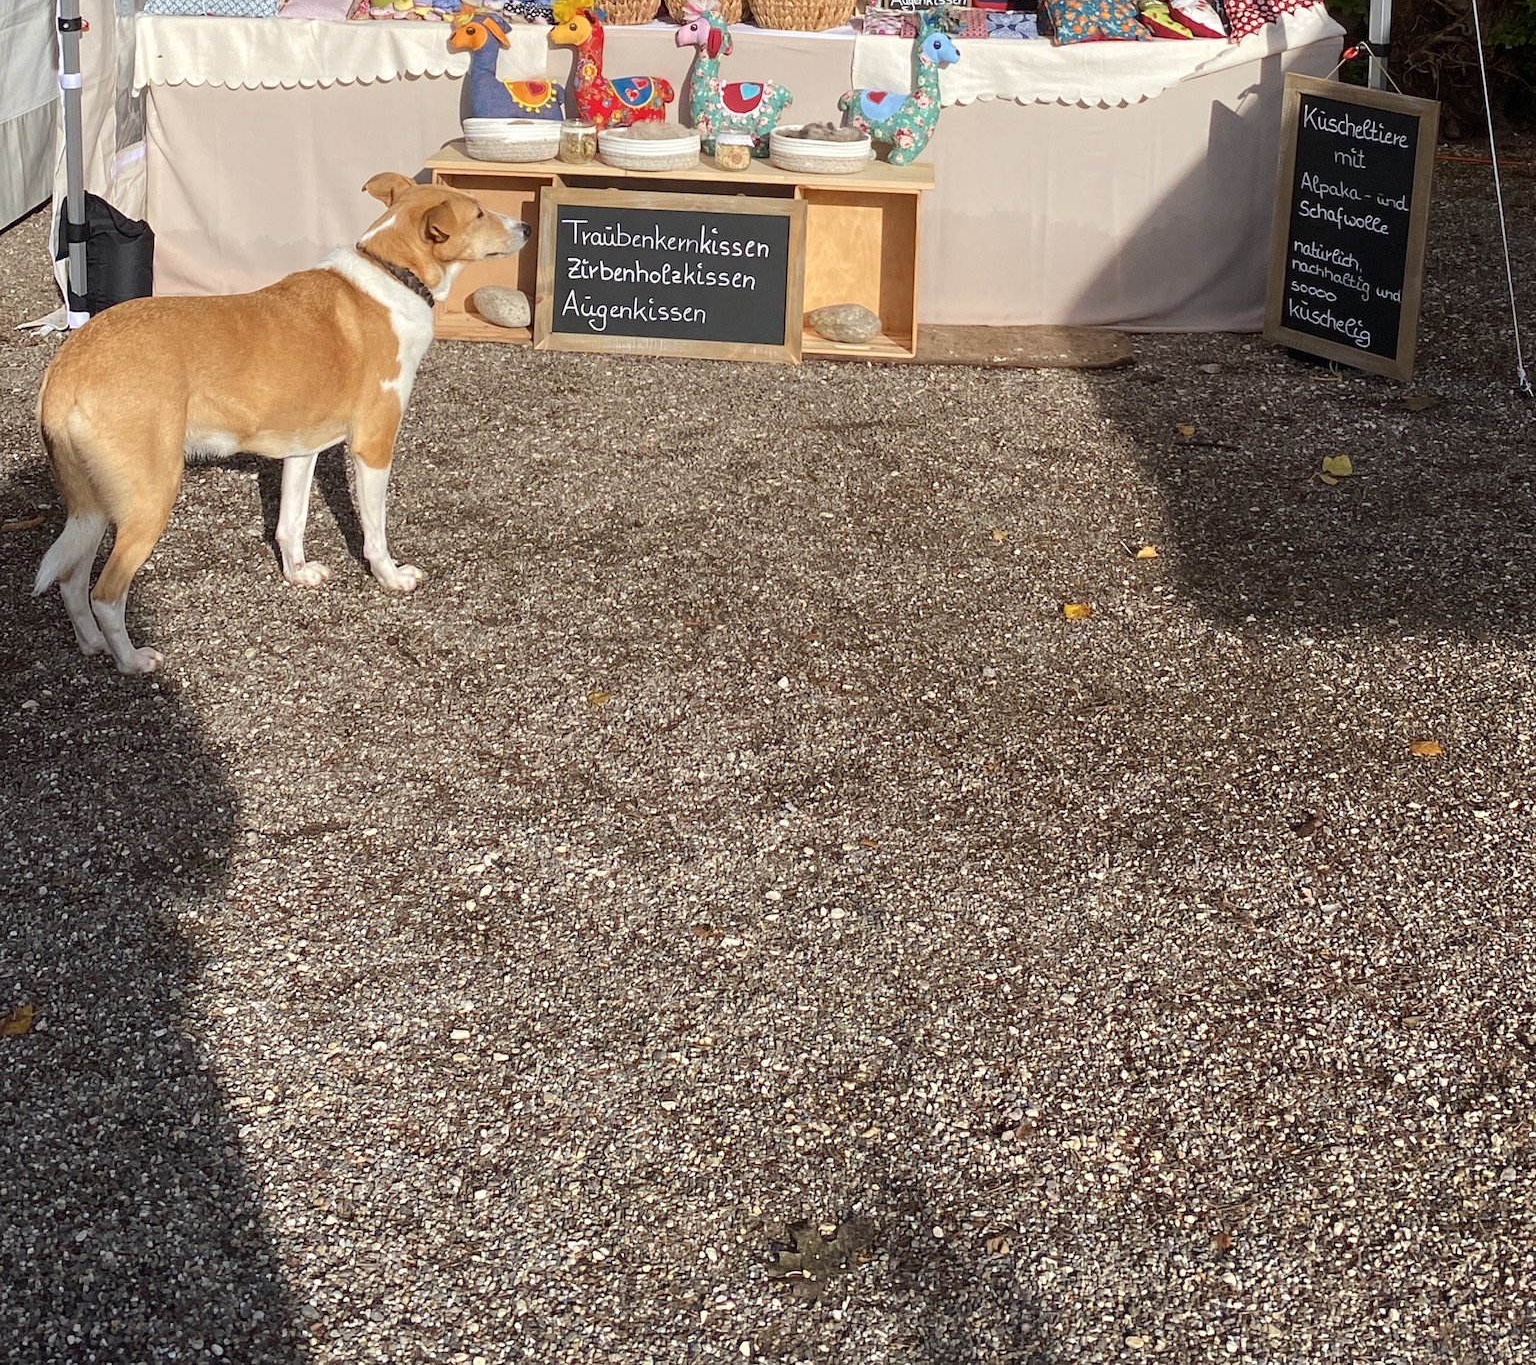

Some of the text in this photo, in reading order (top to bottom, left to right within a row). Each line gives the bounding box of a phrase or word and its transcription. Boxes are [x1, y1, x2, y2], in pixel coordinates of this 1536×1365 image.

[1334, 147, 1367, 169] mit
[1298, 199, 1390, 235] Schafwolle
[567, 256, 756, 291] Zirbenholzkissen
[1292, 258, 1402, 304] nachhaltig und
